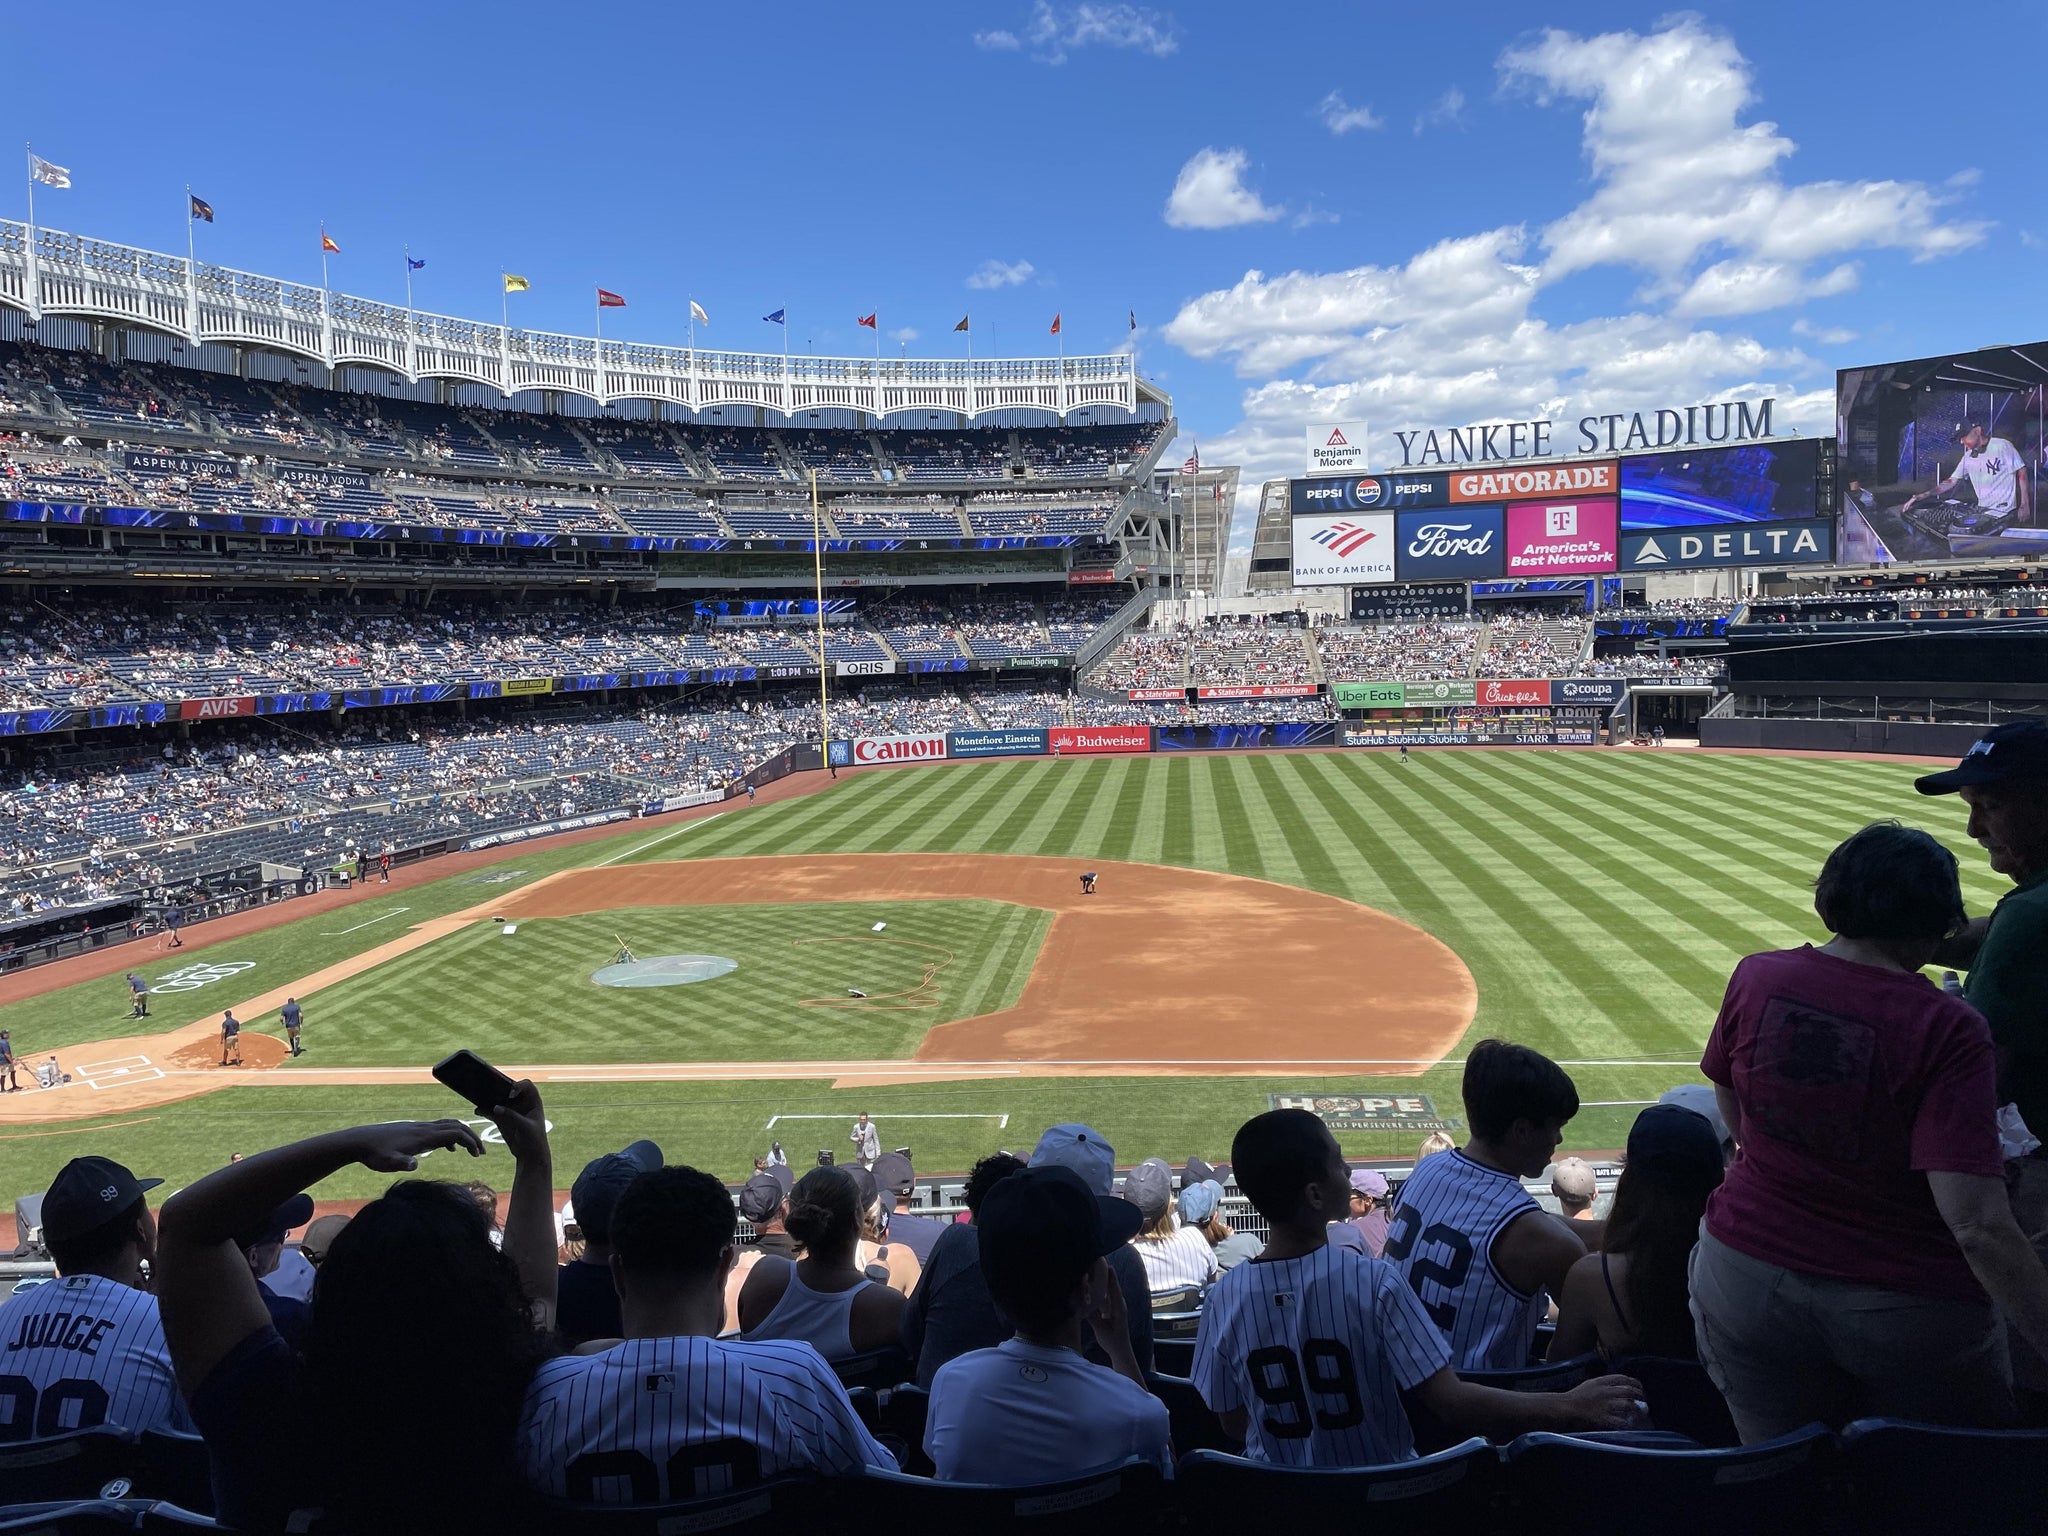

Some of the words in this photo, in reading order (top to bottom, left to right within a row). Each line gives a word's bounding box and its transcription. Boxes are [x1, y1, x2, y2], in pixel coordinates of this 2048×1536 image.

[1393, 420, 1553, 467] YANKEE
[1578, 398, 1776, 455] STADIUM
[1313, 446, 1361, 458] Benjamin
[133, 456, 176, 471] ASPEN
[192, 461, 232, 475] VODKA
[1319, 457, 1353, 467] Moore
[283, 470, 318, 483] ASPEN
[331, 475, 366, 487] VODKA
[1459, 466, 1609, 497] GATORADE
[1306, 489, 1342, 499] PEPSI
[1357, 487, 1379, 495] PEPSI
[1395, 484, 1432, 494] PEPSI
[1408, 523, 1494, 558] Ford
[1680, 528, 1818, 560] DELTA
[1522, 540, 1601, 555] America's
[1511, 555, 1544, 568] Best
[1546, 551, 1613, 565] Network
[1295, 566, 1324, 576] BANK
[1327, 566, 1341, 574] OF
[1343, 564, 1392, 574] AMERICA
[847, 662, 884, 675] ORIS
[1011, 658, 1034, 667] Poland
[1035, 657, 1059, 668] Spring
[770, 668, 787, 677] 1:08
[789, 667, 801, 676] PM
[1337, 691, 1368, 702] Uber
[1370, 690, 1401, 701] Eats
[1486, 682, 1541, 703] Chick-fil-A
[1578, 685, 1612, 696] coupa
[200, 700, 239, 716] AVIS
[955, 736, 1003, 746] Montefiore
[1005, 733, 1040, 744] Einstein
[1077, 735, 1144, 747] Budweiser
[1347, 736, 1384, 745] StubHub
[1388, 735, 1425, 744] StubHub
[1428, 735, 1468, 744] StubHub
[1516, 734, 1549, 743] STARR
[856, 738, 945, 761] Canon
[1352, 1121, 1403, 1130] PERSEVERE
[1418, 1121, 1445, 1129] EXCEL
[100, 1186, 118, 1202] 99
[8, 1312, 116, 1356] JUDGE
[1247, 1338, 1364, 1440] 99
